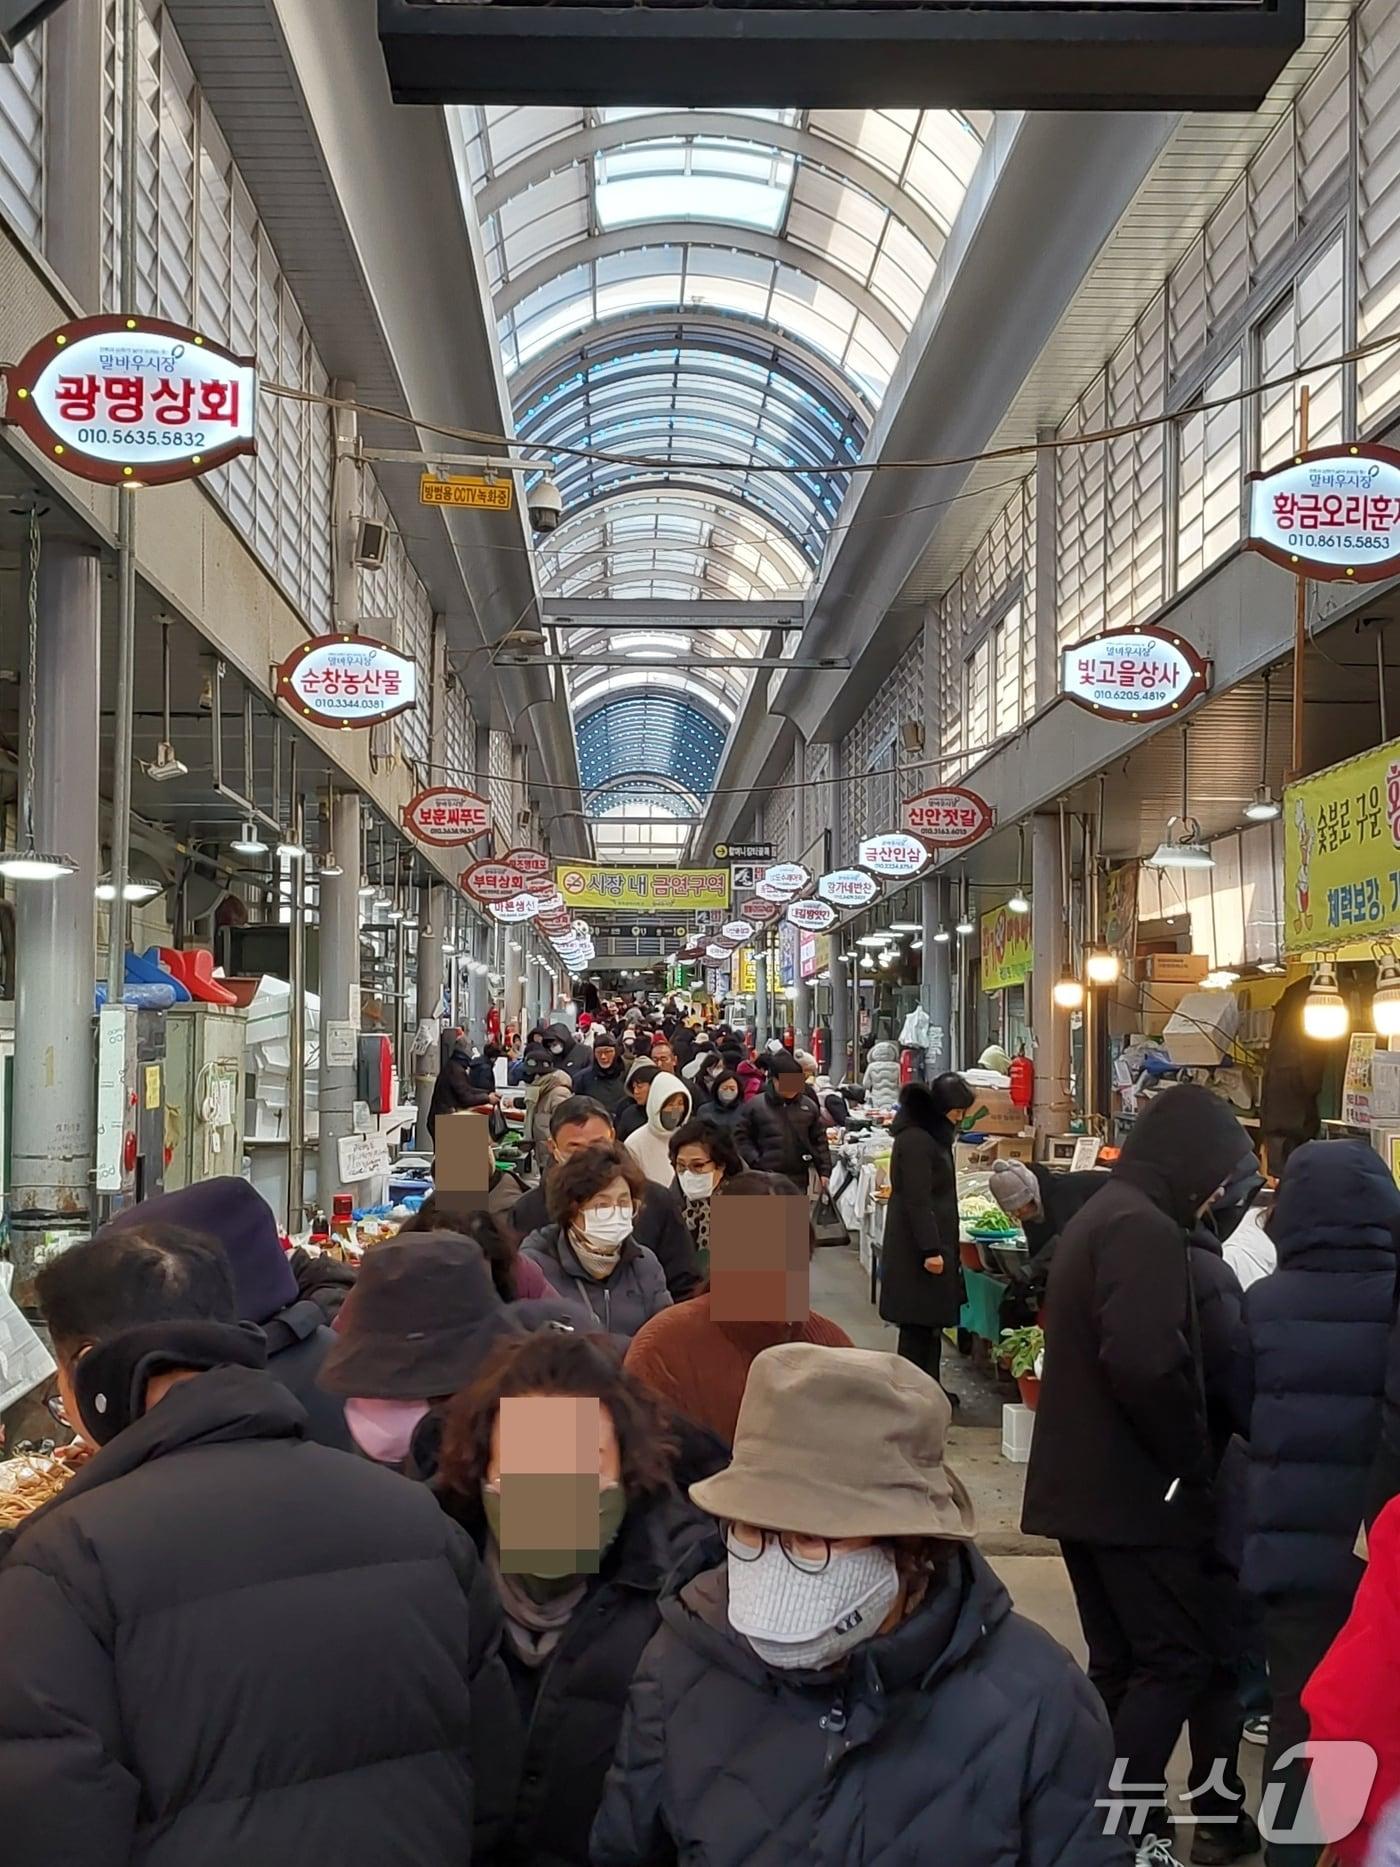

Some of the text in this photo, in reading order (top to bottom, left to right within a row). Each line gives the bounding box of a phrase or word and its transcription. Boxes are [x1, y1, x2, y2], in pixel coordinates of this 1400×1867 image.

[99, 354, 176, 373] 말바우시장
[54, 373, 240, 428] 광명상회
[77, 428, 206, 447] 010.5635.5832
[1308, 474, 1373, 490] 말바우시장
[1288, 533, 1390, 549] 010.8615.5853
[300, 667, 403, 696] 순창농산물
[1078, 658, 1180, 689] 빛고을상사
[314, 698, 385, 709] 010.3344.0381
[1093, 690, 1167, 701] 010.6205.4819
[418, 807, 487, 826] 보훈씨푸드
[908, 807, 977, 828] 신안젓갈
[1316, 798, 1352, 856] 숯불로
[1355, 785, 1382, 845] 구운
[864, 846, 922, 863] 금산인삼
[586, 872, 625, 897] 시장
[627, 872, 649, 897] 내
[651, 872, 726, 898] 금연구역
